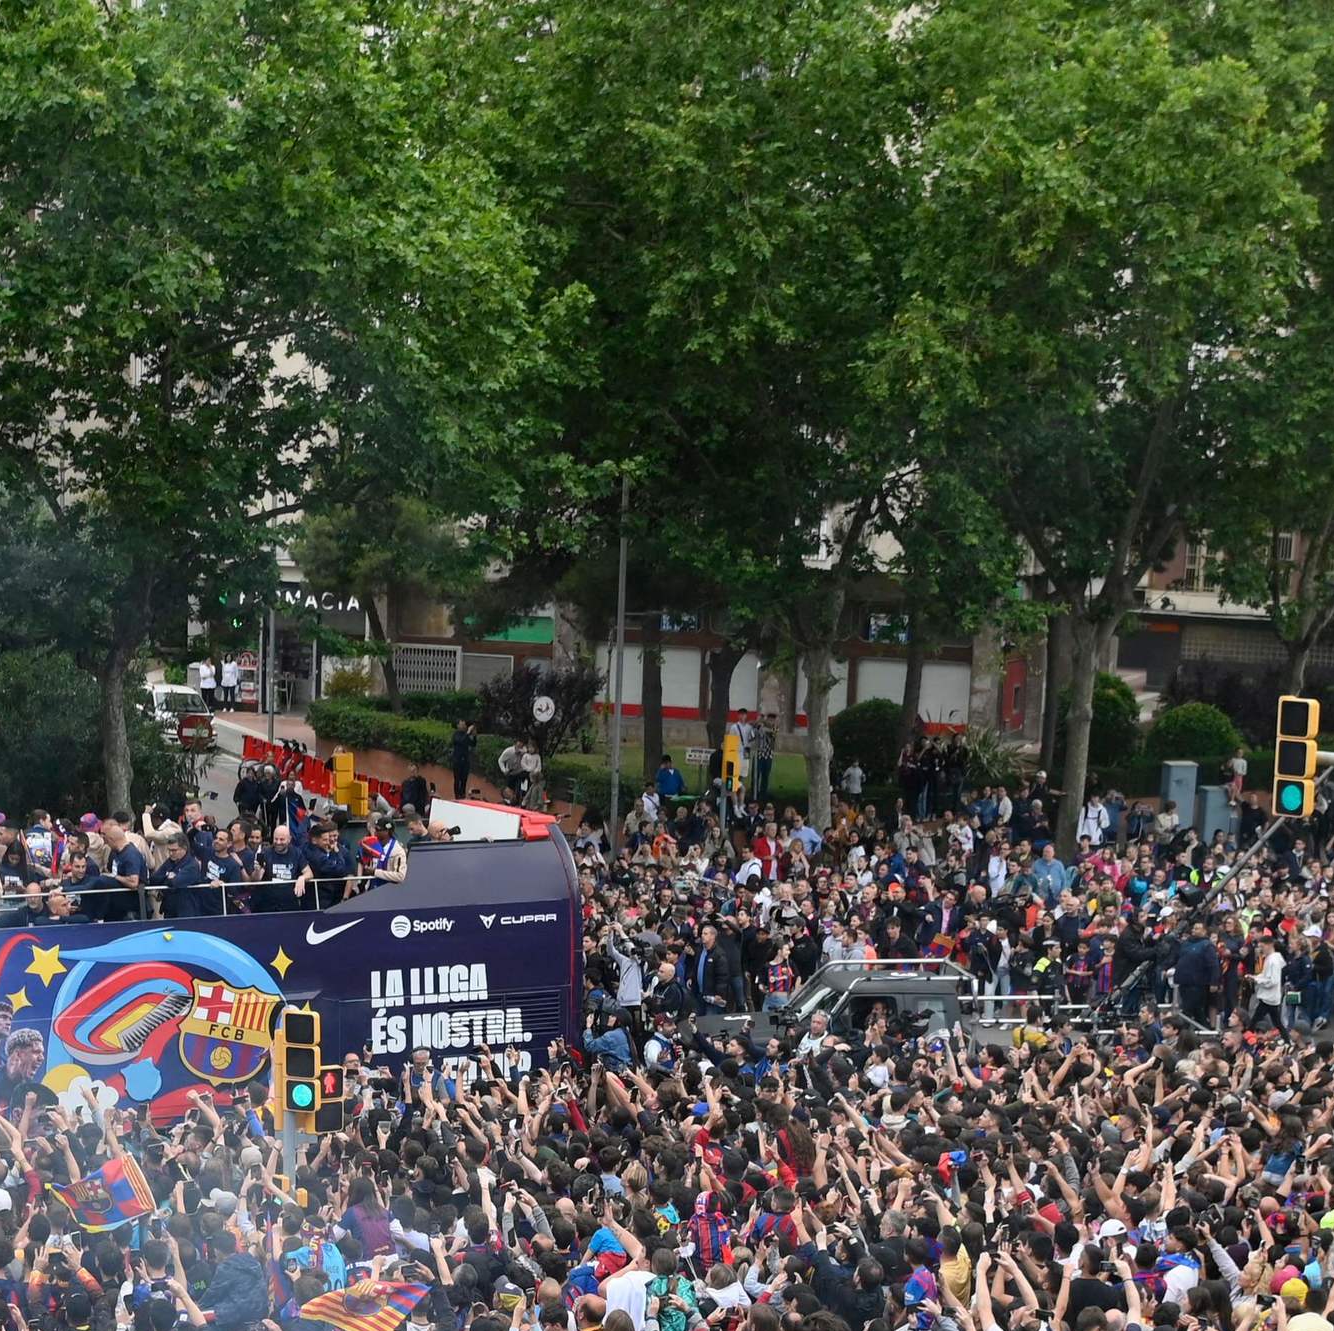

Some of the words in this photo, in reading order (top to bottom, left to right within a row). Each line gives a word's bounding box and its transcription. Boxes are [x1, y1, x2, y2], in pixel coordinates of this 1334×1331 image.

[239, 590, 360, 612] FMACIA
[413, 917, 454, 934] Spotify
[501, 914, 557, 925] CUPRA
[371, 970, 405, 1009] LA
[410, 963, 489, 1006] LLIGA
[209, 1023, 245, 1042] FCB
[372, 1008, 407, 1055] ÉS
